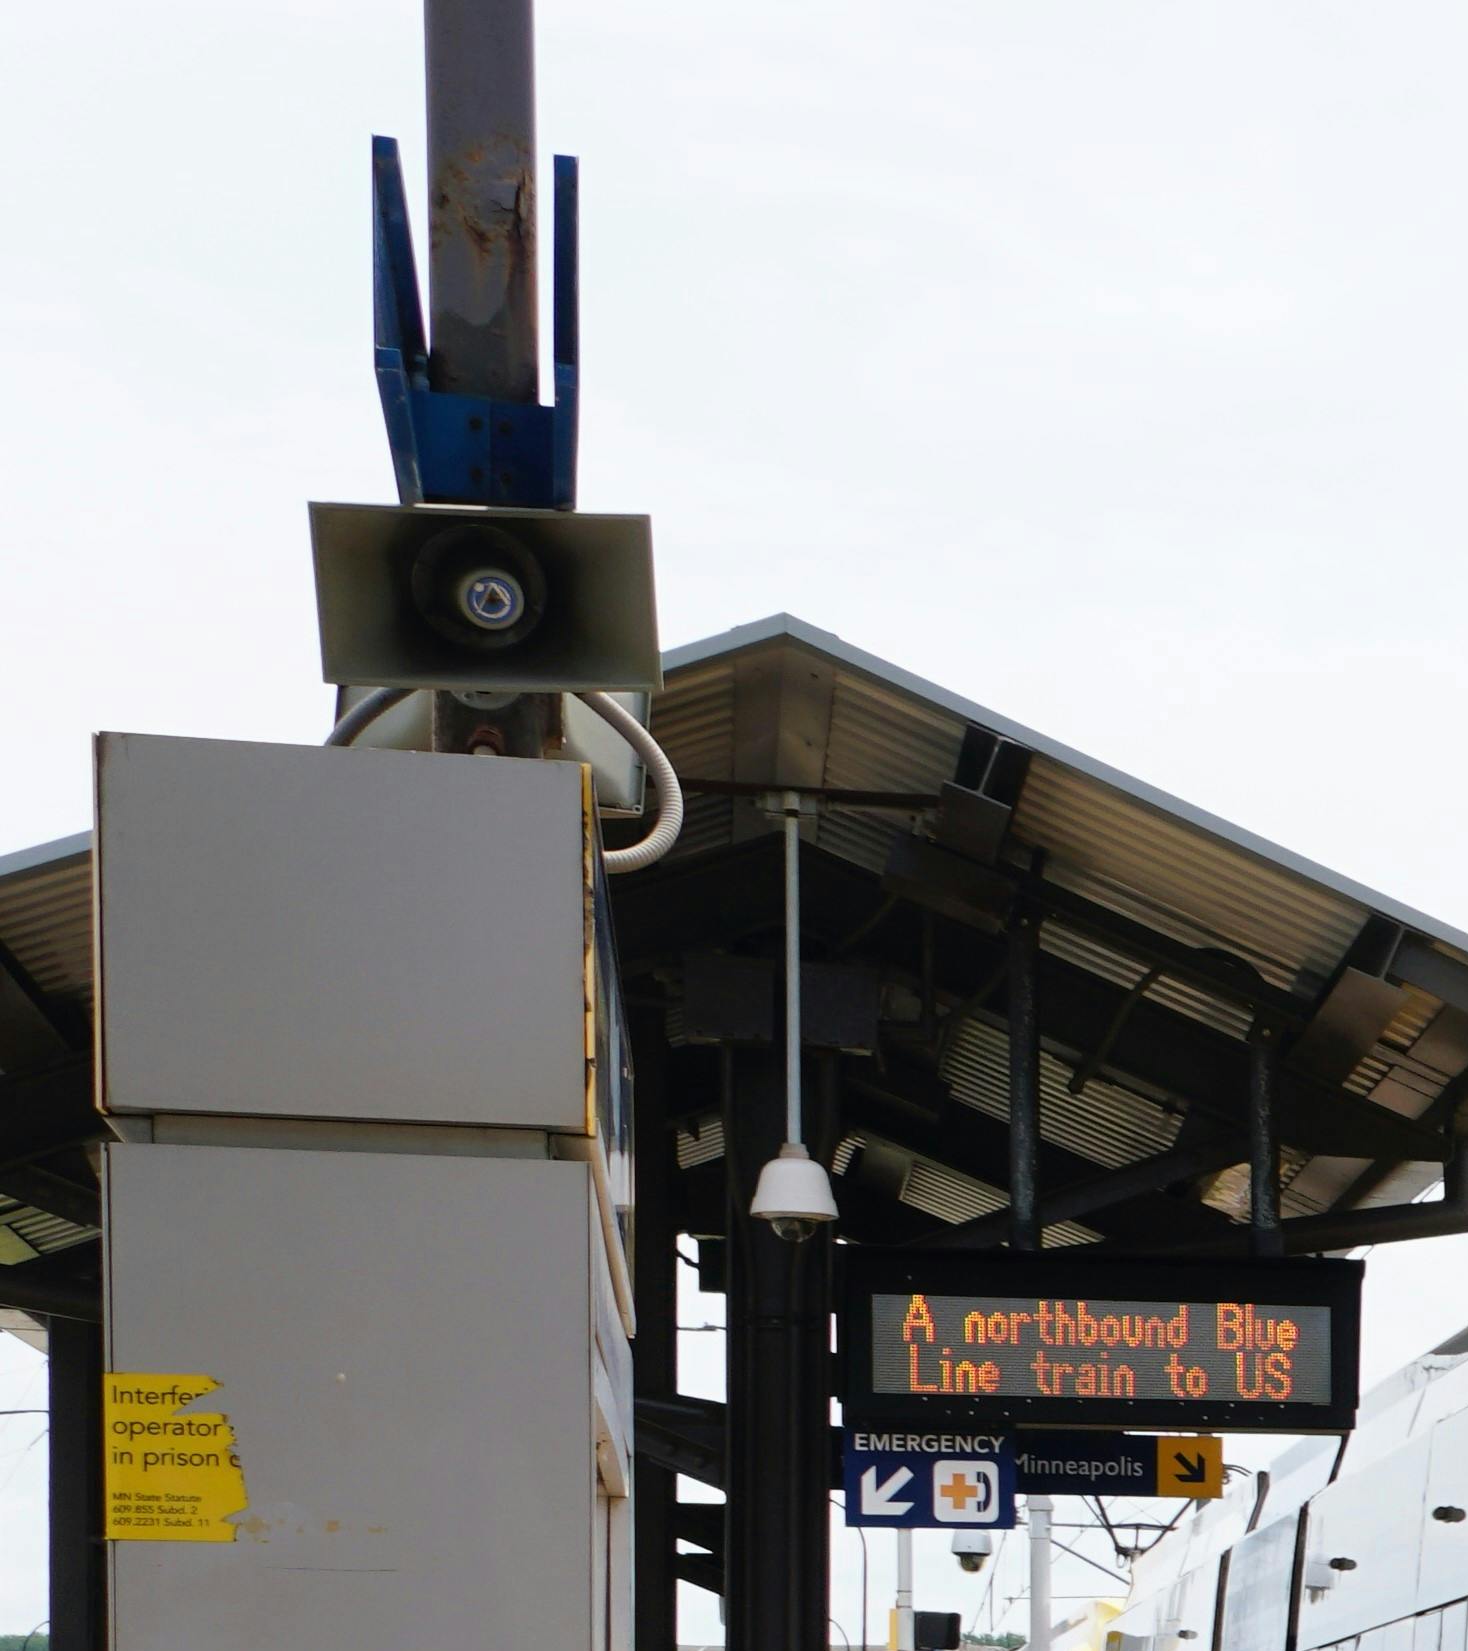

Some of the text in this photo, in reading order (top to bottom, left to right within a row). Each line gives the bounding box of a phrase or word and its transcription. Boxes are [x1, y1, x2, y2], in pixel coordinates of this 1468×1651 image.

[903, 1293, 1300, 1351] A northbound Blue
[909, 1344, 1295, 1400] Line train to US
[112, 1384, 209, 1406] Interfe
[112, 1420, 223, 1442] operator
[854, 1433, 1005, 1454] EMERGENCY
[112, 1446, 134, 1465] in
[143, 1447, 220, 1472] prison
